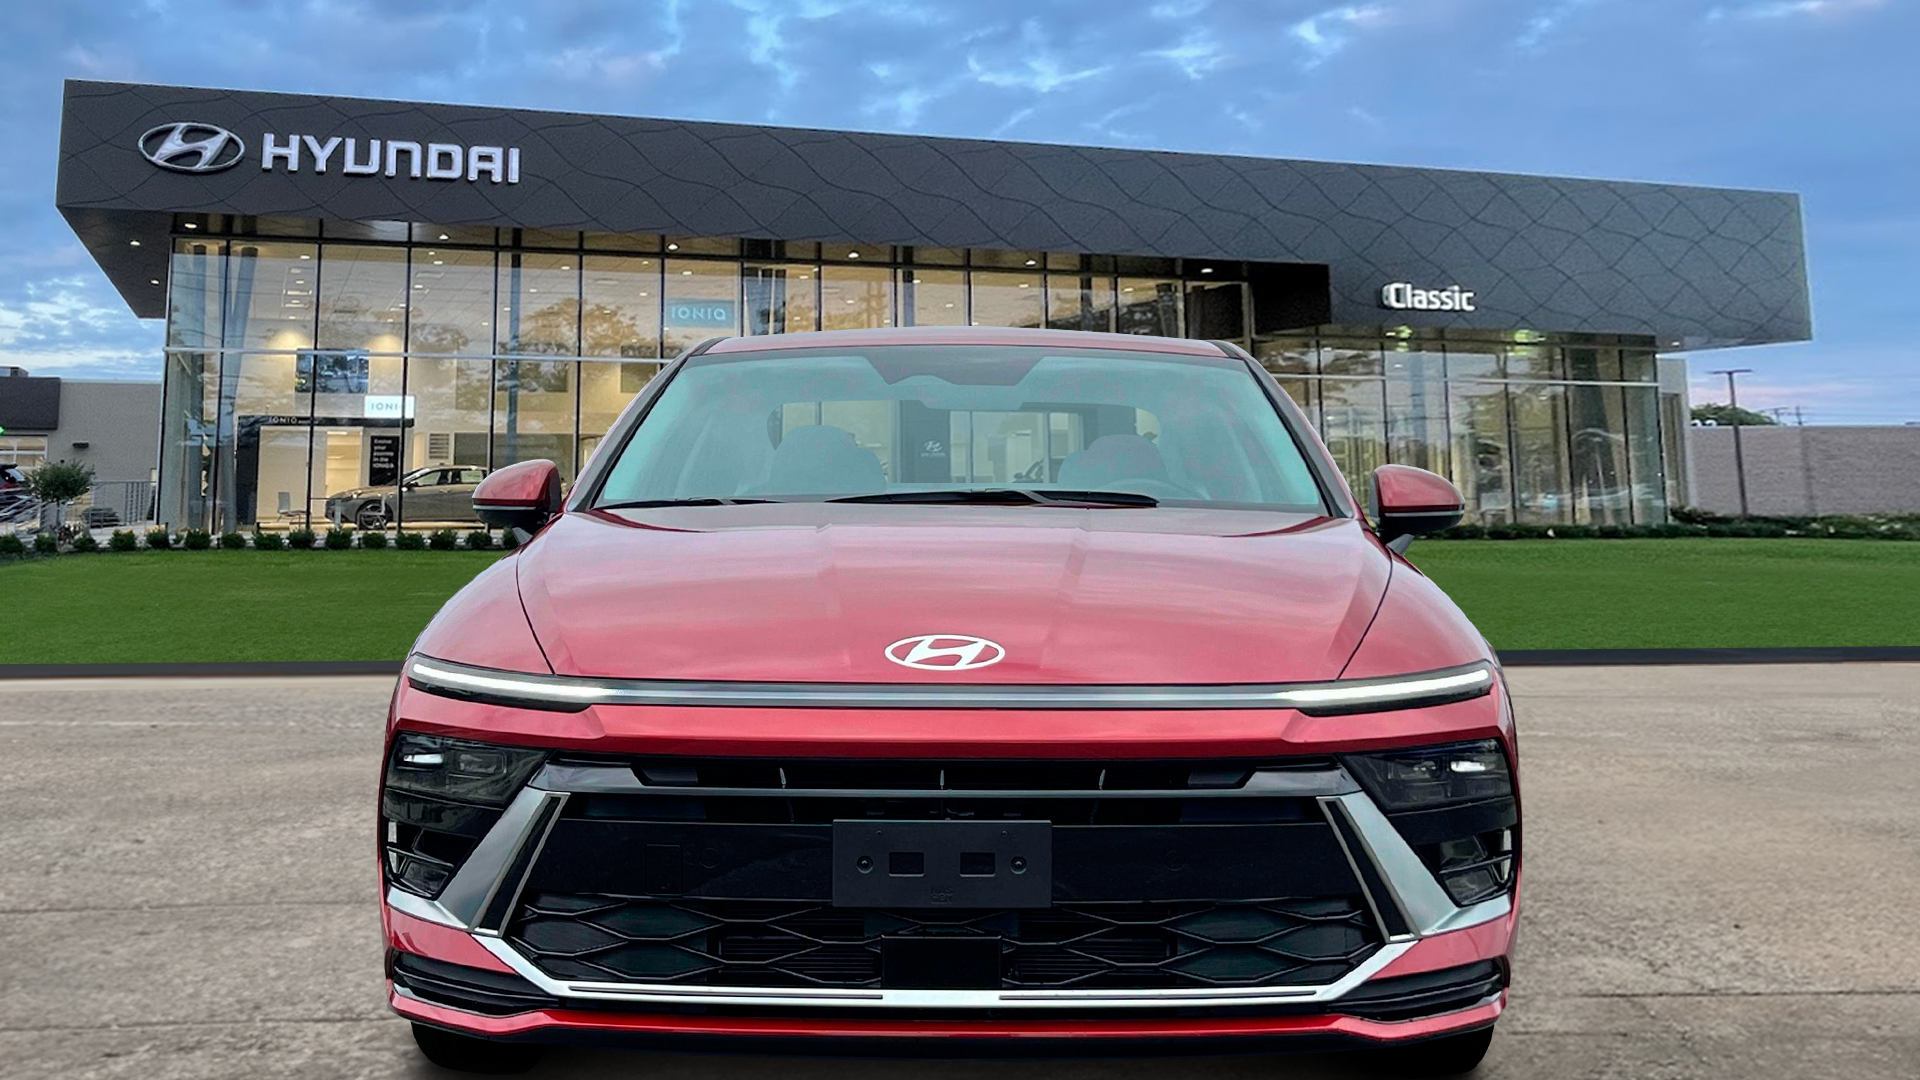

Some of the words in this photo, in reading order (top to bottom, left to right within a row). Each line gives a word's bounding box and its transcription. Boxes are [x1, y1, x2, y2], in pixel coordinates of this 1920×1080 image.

[261, 132, 520, 185] HYUNDAI
[1382, 282, 1476, 311] Classic
[671, 307, 727, 321] IONIQ
[371, 402, 403, 411] IONI
